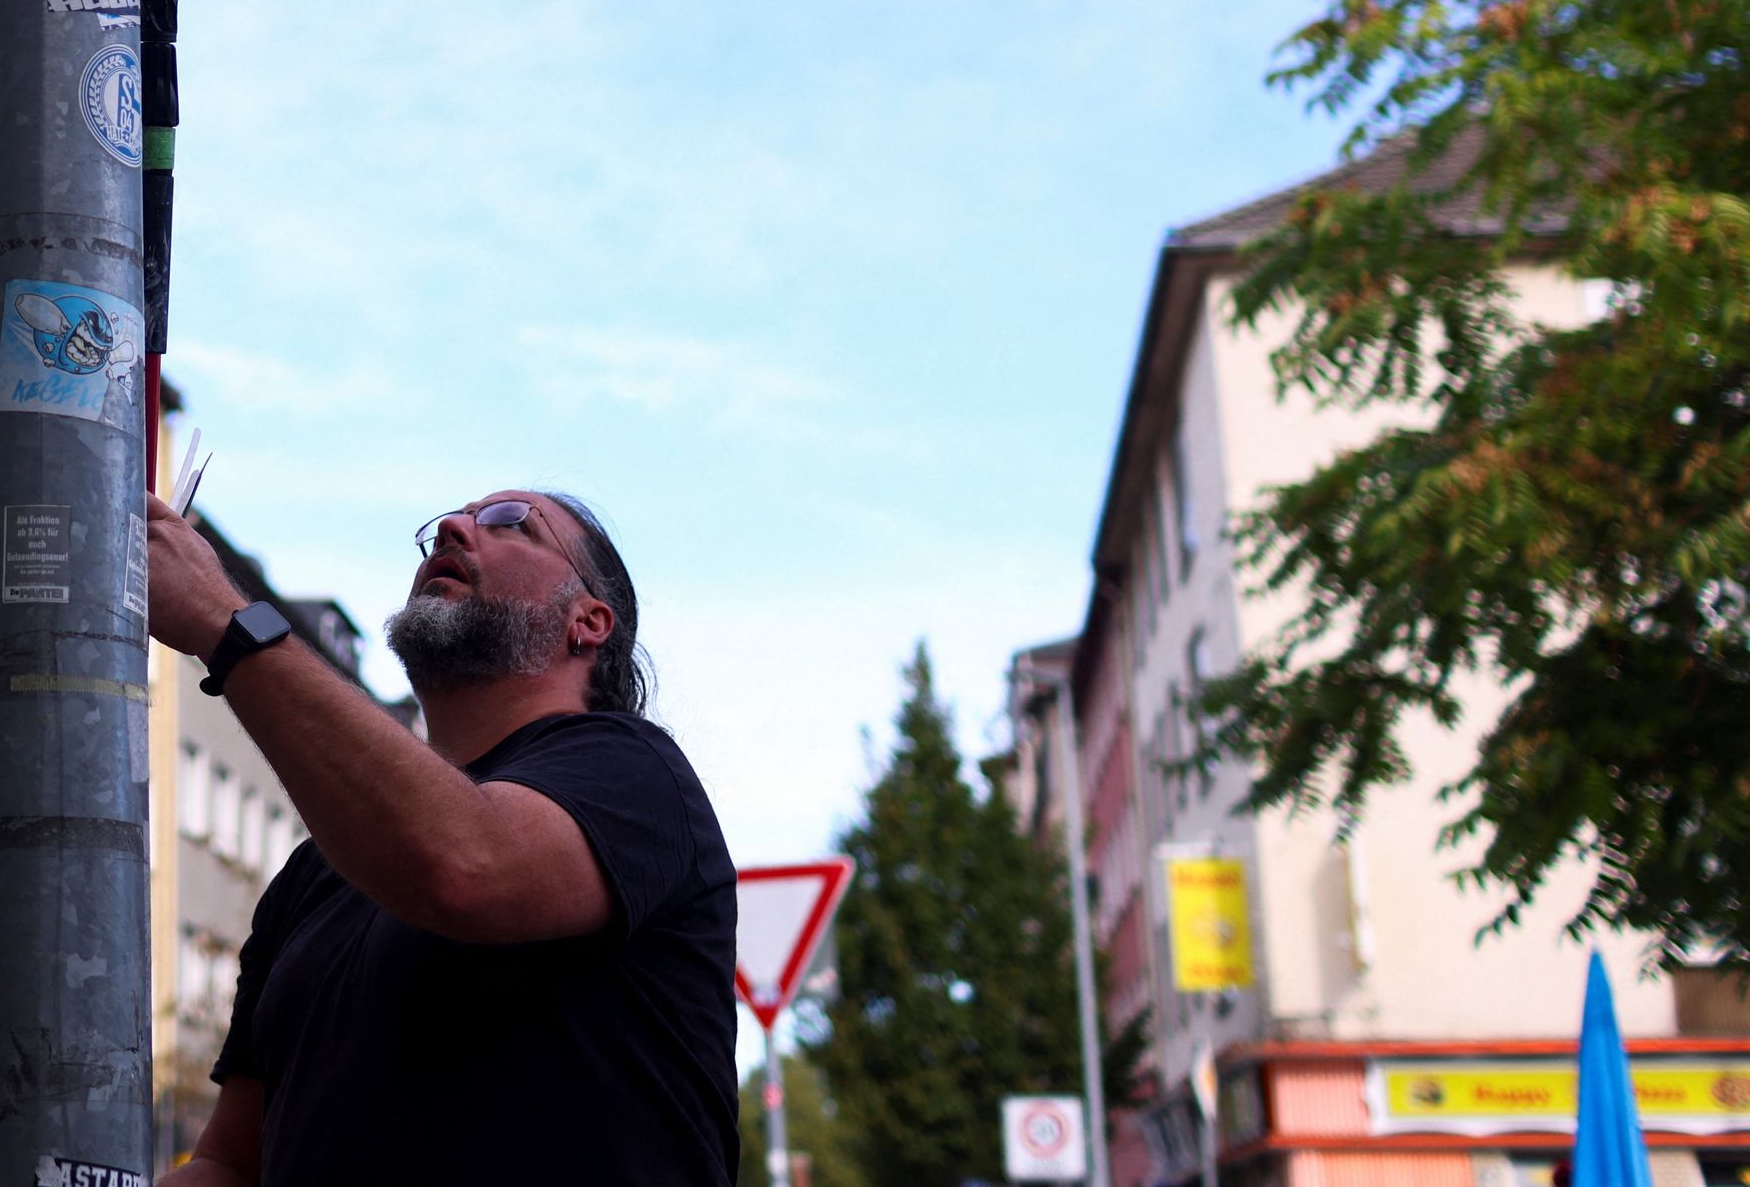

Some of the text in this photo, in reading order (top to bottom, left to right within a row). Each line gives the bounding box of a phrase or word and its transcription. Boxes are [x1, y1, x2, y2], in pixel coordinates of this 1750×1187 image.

[16, 515, 60, 526] Als Fraktion
[17, 528, 27, 537] ab
[47, 527, 59, 537] für
[9, 588, 20, 597] Die
